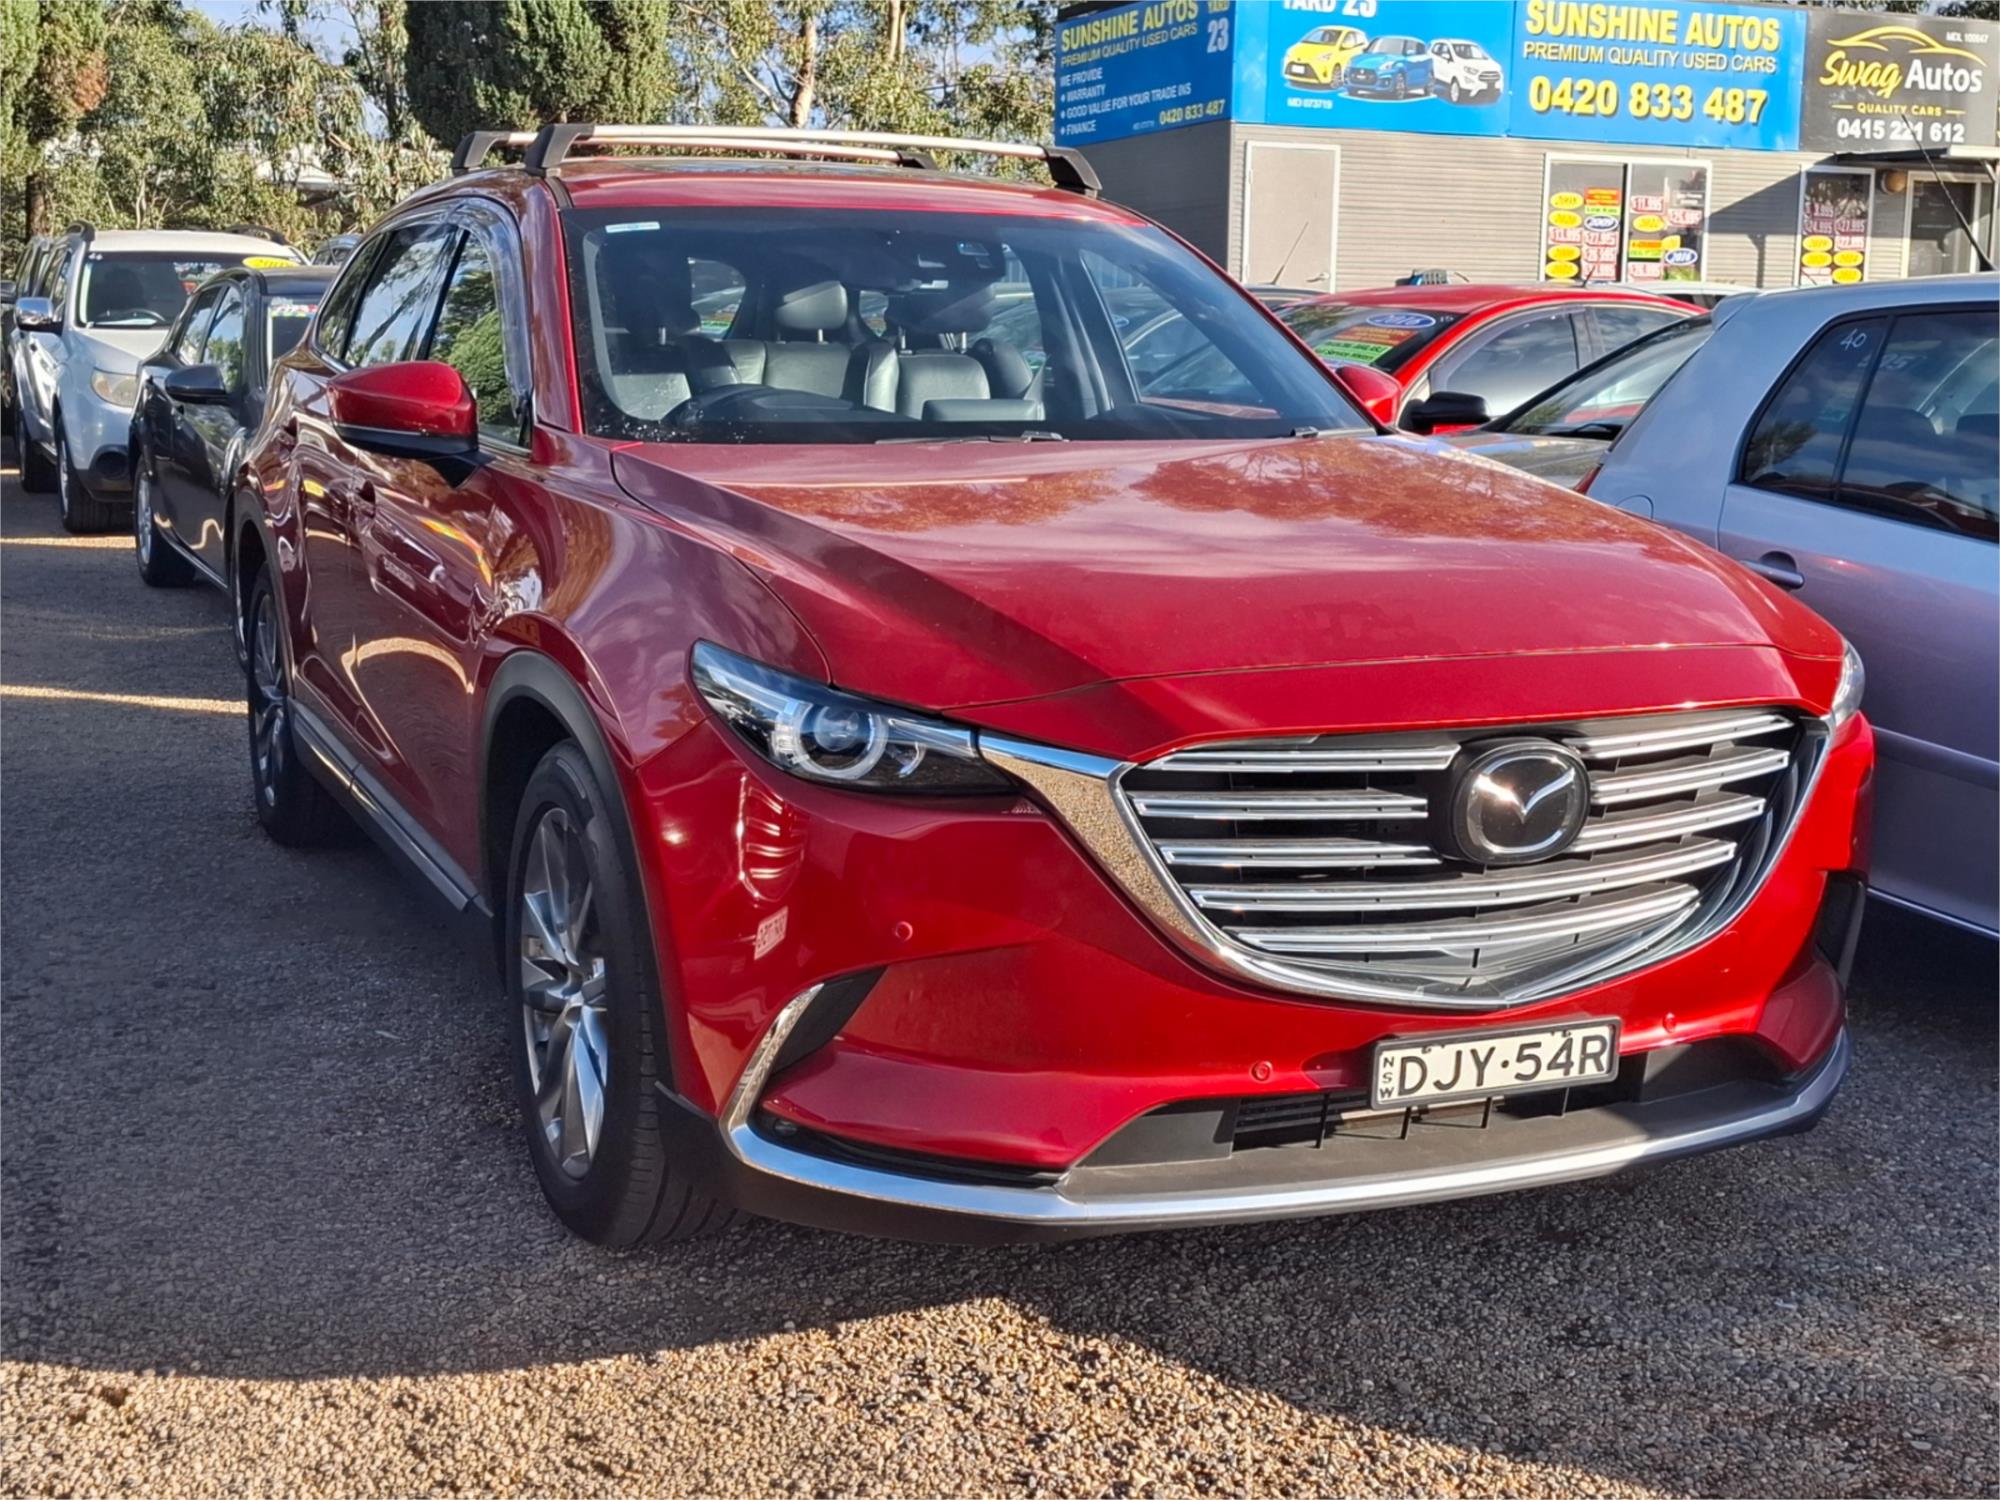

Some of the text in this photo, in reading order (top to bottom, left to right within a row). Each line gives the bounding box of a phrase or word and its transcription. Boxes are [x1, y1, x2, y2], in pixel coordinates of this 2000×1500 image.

[1061, 0, 1199, 51] SUNSHINE AUTOS
[1207, 17, 1229, 53] 23
[1525, 0, 1780, 52] SUNSHINE AUTOS
[1061, 22, 1198, 68] PREMIUM QUALITY USED CARS
[1523, 41, 1777, 73] PREMIUM QUALITY USED CARS
[1072, 67, 1103, 86] PROVIDE
[1819, 50, 1983, 99] Swag Autos
[1066, 84, 1106, 102] WARRANTY
[1066, 105, 1087, 119] GOOD
[1088, 101, 1111, 115] VALUE
[1111, 96, 1128, 111] FOR
[1128, 92, 1150, 106] YOUR
[1151, 86, 1177, 100] TRADE
[1529, 75, 1768, 124] 0420 833 487
[1160, 109, 1183, 126] 0420
[1185, 104, 1203, 120] 833
[1206, 99, 1225, 116] 487
[1857, 102, 1942, 117] QUALITY CARS
[1066, 120, 1097, 136] FINANCE
[1837, 118, 1965, 143] 0415 221 612
[1840, 328, 1867, 351] 40
